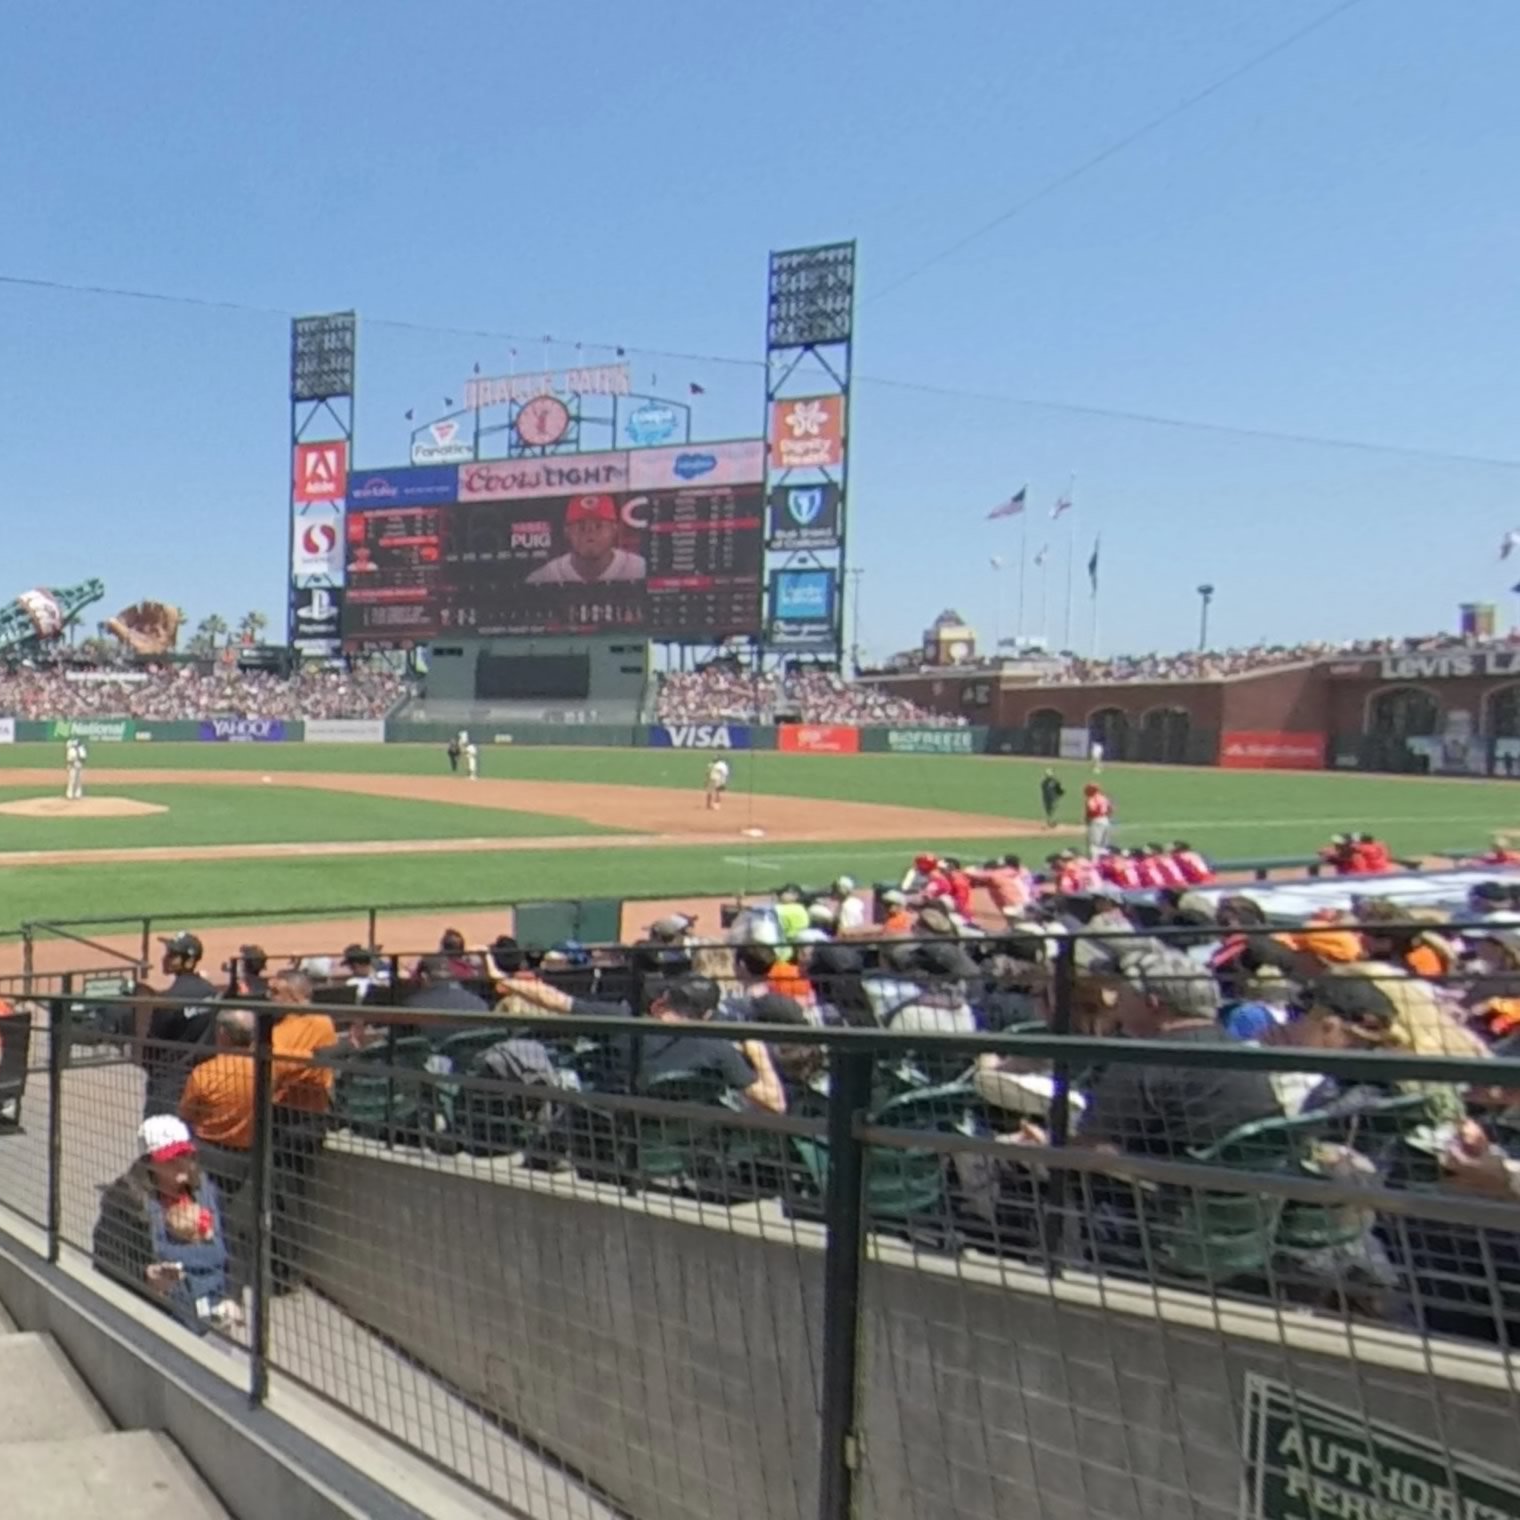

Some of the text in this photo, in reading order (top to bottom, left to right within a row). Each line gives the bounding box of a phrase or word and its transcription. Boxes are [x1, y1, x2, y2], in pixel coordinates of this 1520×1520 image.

[567, 364, 630, 396] PARK
[414, 442, 475, 461] Fanatics
[779, 438, 832, 455] Dignity
[782, 452, 830, 466] Health
[543, 463, 614, 485] LIGHT
[304, 480, 336, 494] Adobe
[510, 532, 552, 548] PUIG
[70, 722, 126, 737] National
[212, 718, 273, 738] YAHOO!
[668, 726, 731, 748] VISA
